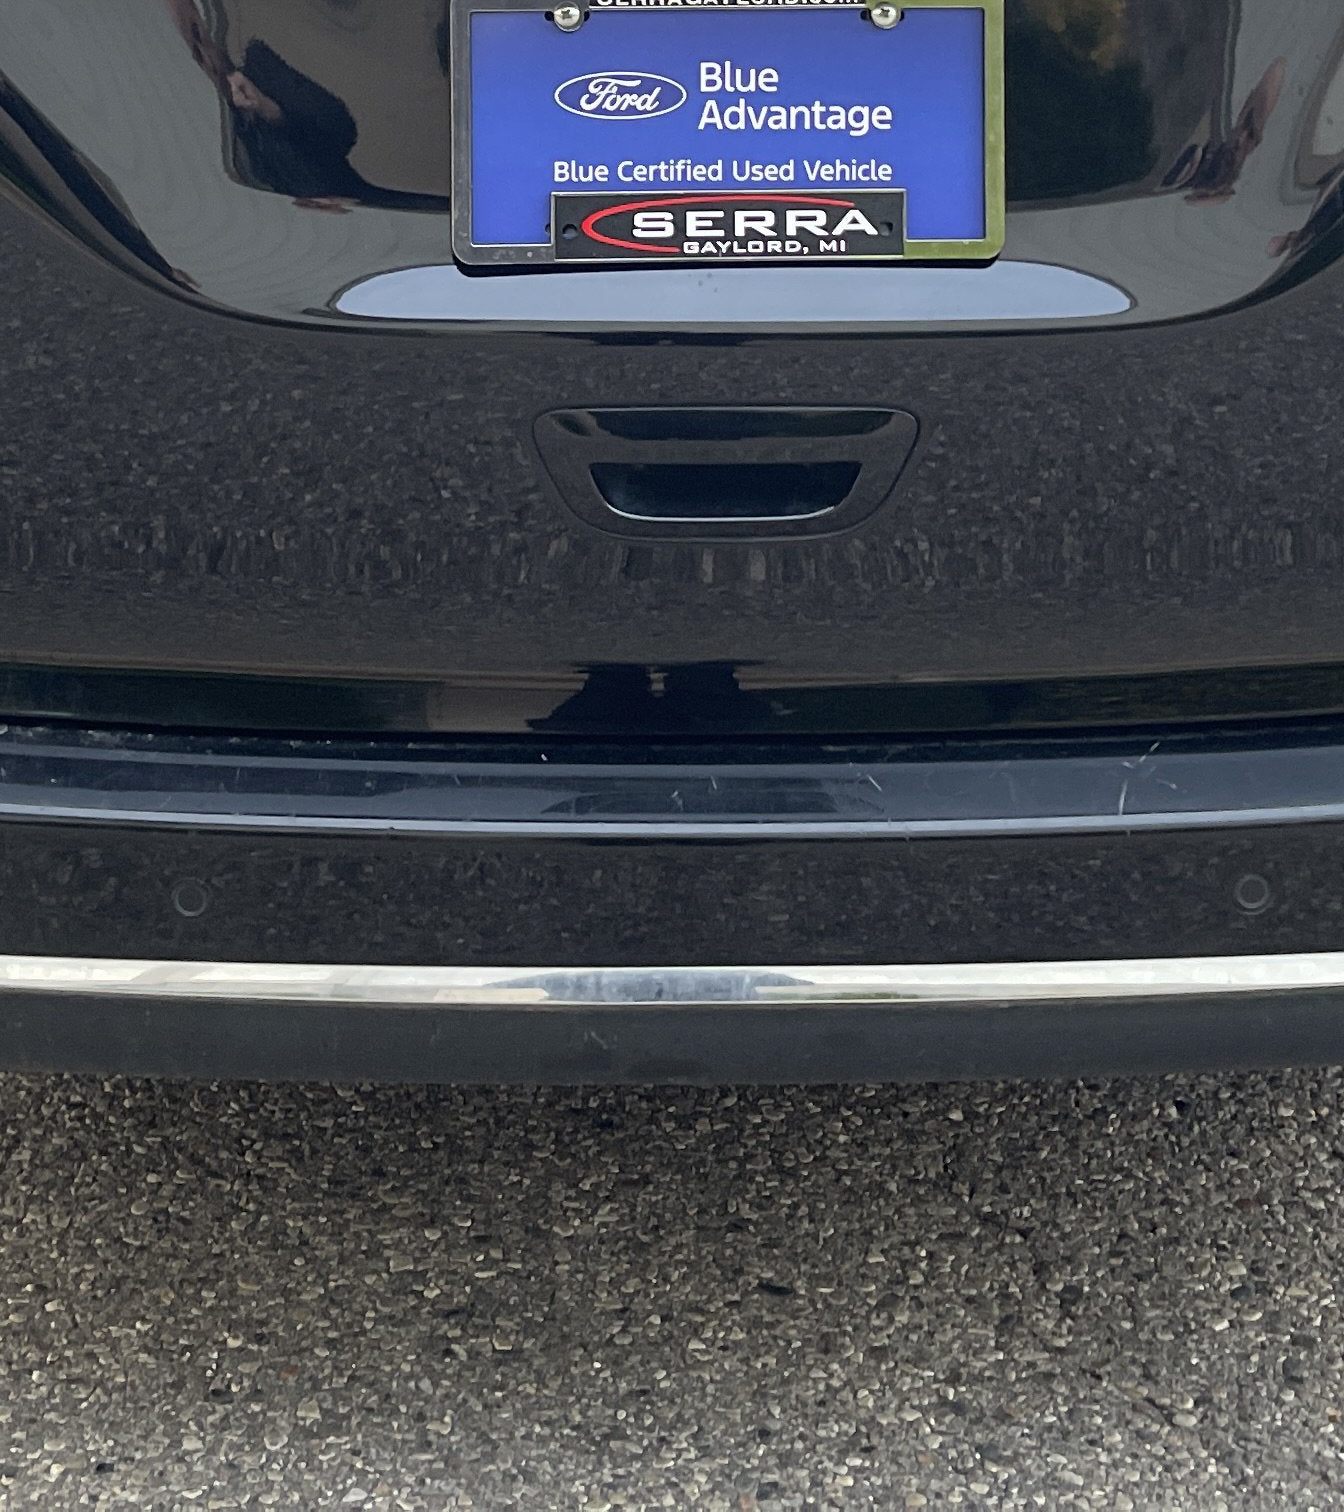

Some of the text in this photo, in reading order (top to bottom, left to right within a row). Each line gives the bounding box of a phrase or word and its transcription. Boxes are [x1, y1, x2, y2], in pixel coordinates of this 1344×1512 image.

[699, 60, 780, 93] Blue
[579, 76, 662, 112] Ford
[697, 98, 893, 137] Advantage
[553, 158, 893, 183] Blue Certified Used Vehicle
[631, 208, 879, 238] SERRA
[682, 239, 847, 256] GAYLORD, MI
